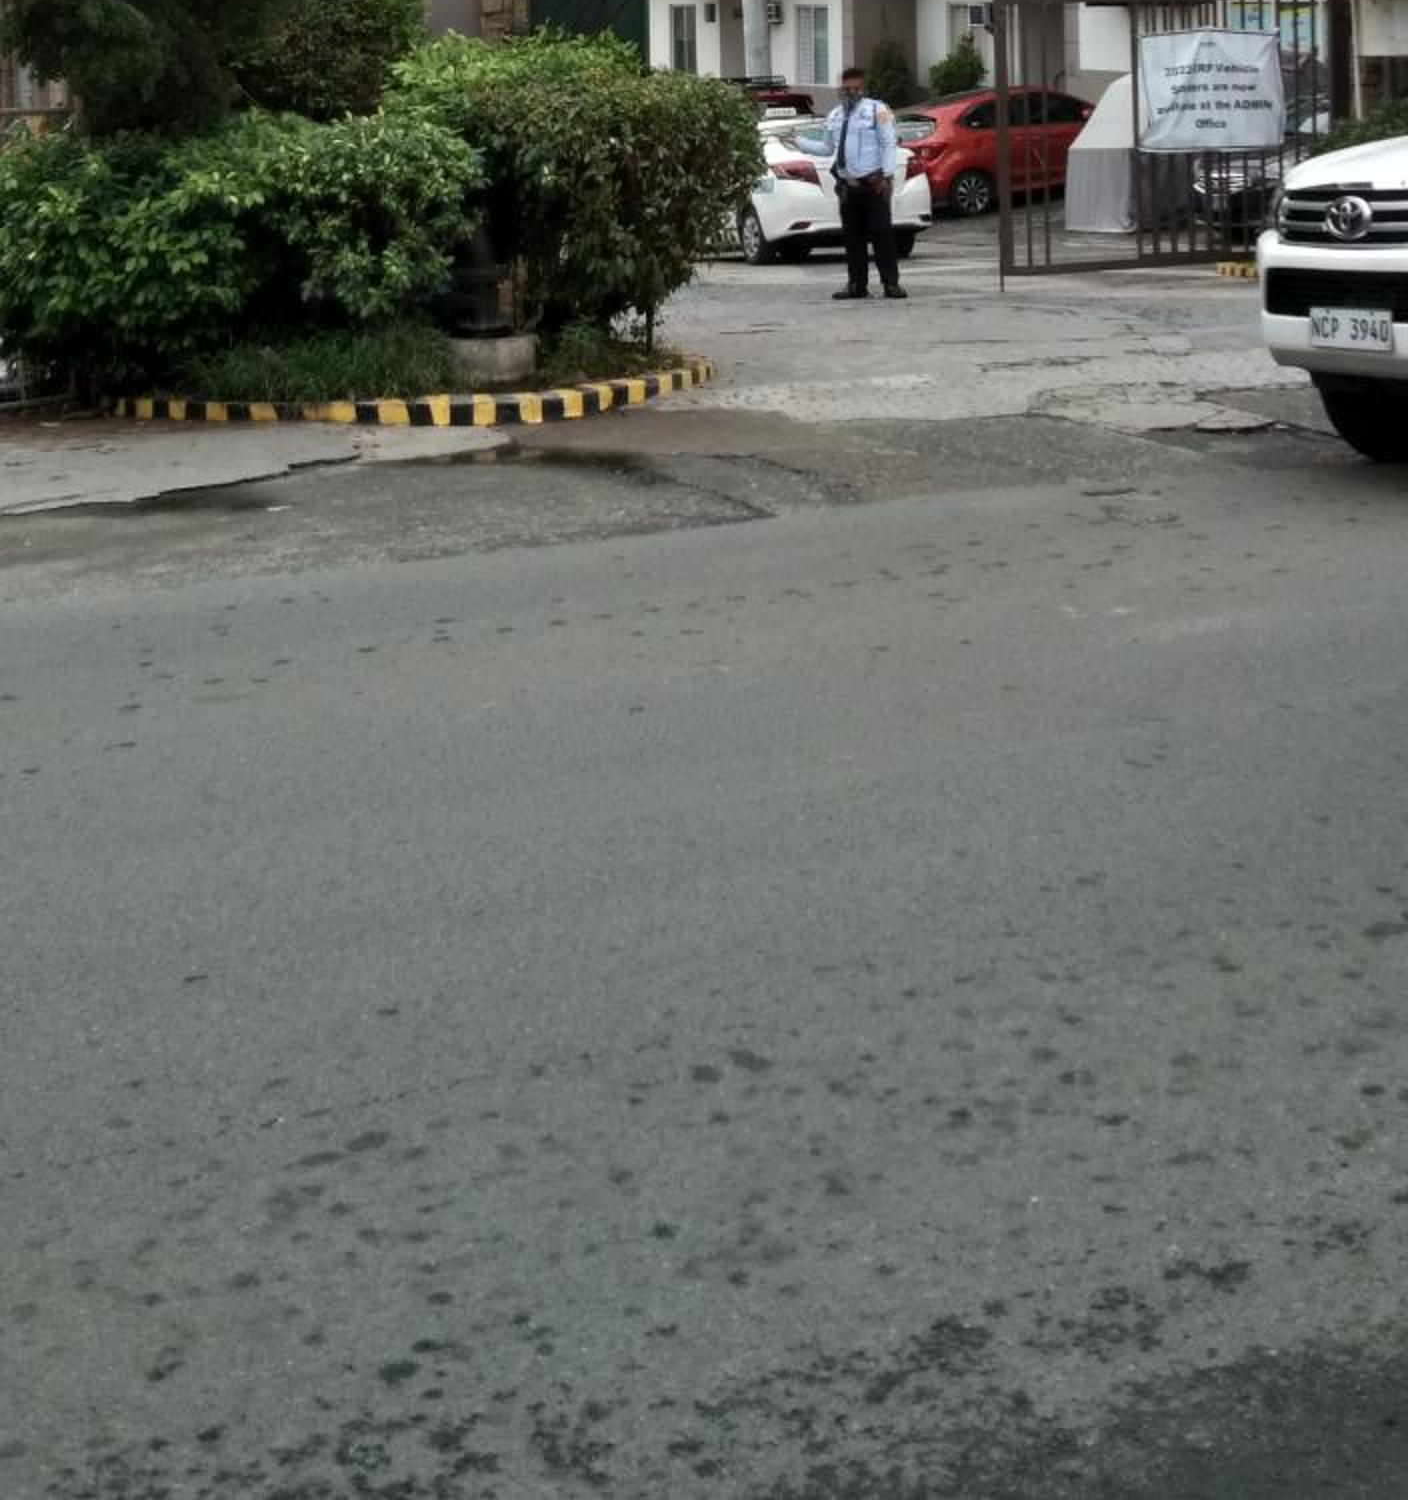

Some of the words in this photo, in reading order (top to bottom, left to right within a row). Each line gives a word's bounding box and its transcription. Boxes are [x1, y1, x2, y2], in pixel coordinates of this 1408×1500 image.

[1216, 63, 1260, 74] Vehicle
[1212, 84, 1229, 92] are
[1232, 84, 1257, 92] now
[1199, 101, 1211, 110] at
[1215, 101, 1231, 110] the
[1234, 100, 1274, 111] ADMIN
[1195, 118, 1228, 129] Office
[1311, 316, 1339, 339] NCP
[1349, 318, 1389, 342] 3940
